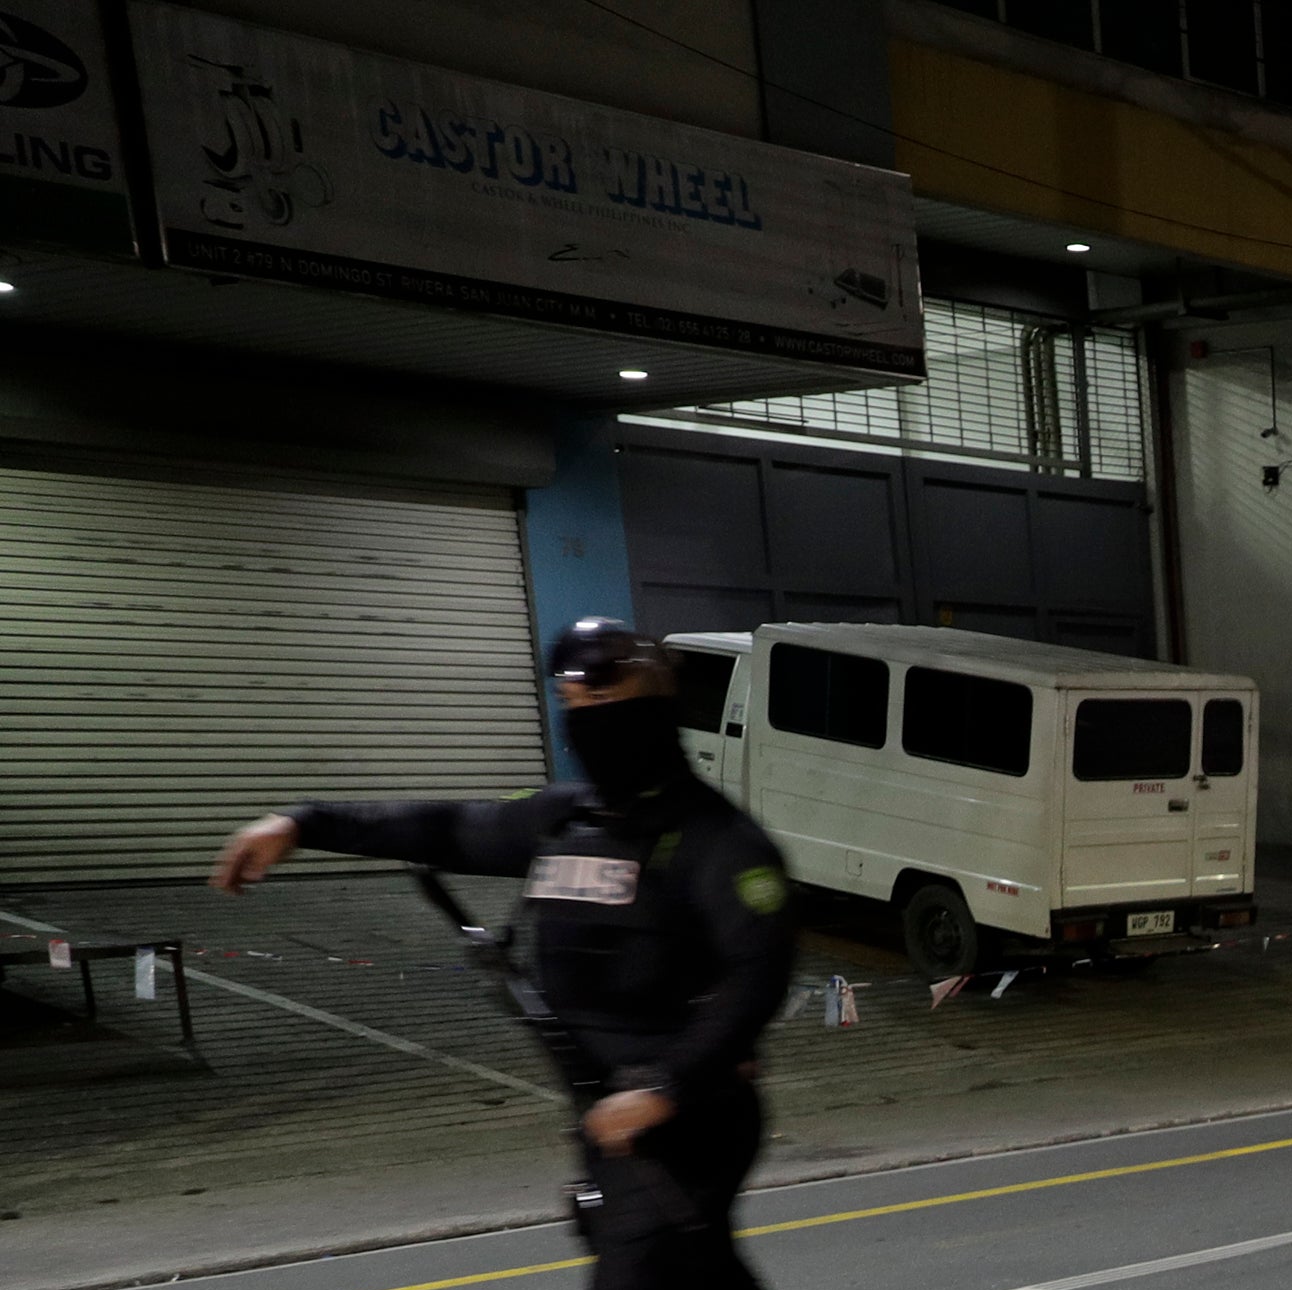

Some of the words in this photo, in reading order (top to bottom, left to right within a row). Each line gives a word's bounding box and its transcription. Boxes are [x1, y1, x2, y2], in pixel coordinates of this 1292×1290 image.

[370, 99, 578, 194] CASTOR
[603, 147, 763, 231] WHEEL
[187, 240, 228, 263] UNIT
[300, 261, 372, 286] DOMINGO
[460, 285, 491, 304] SAN
[496, 290, 532, 310] JUAN
[536, 297, 565, 315] CITY
[1132, 782, 1166, 794] PRIVATE
